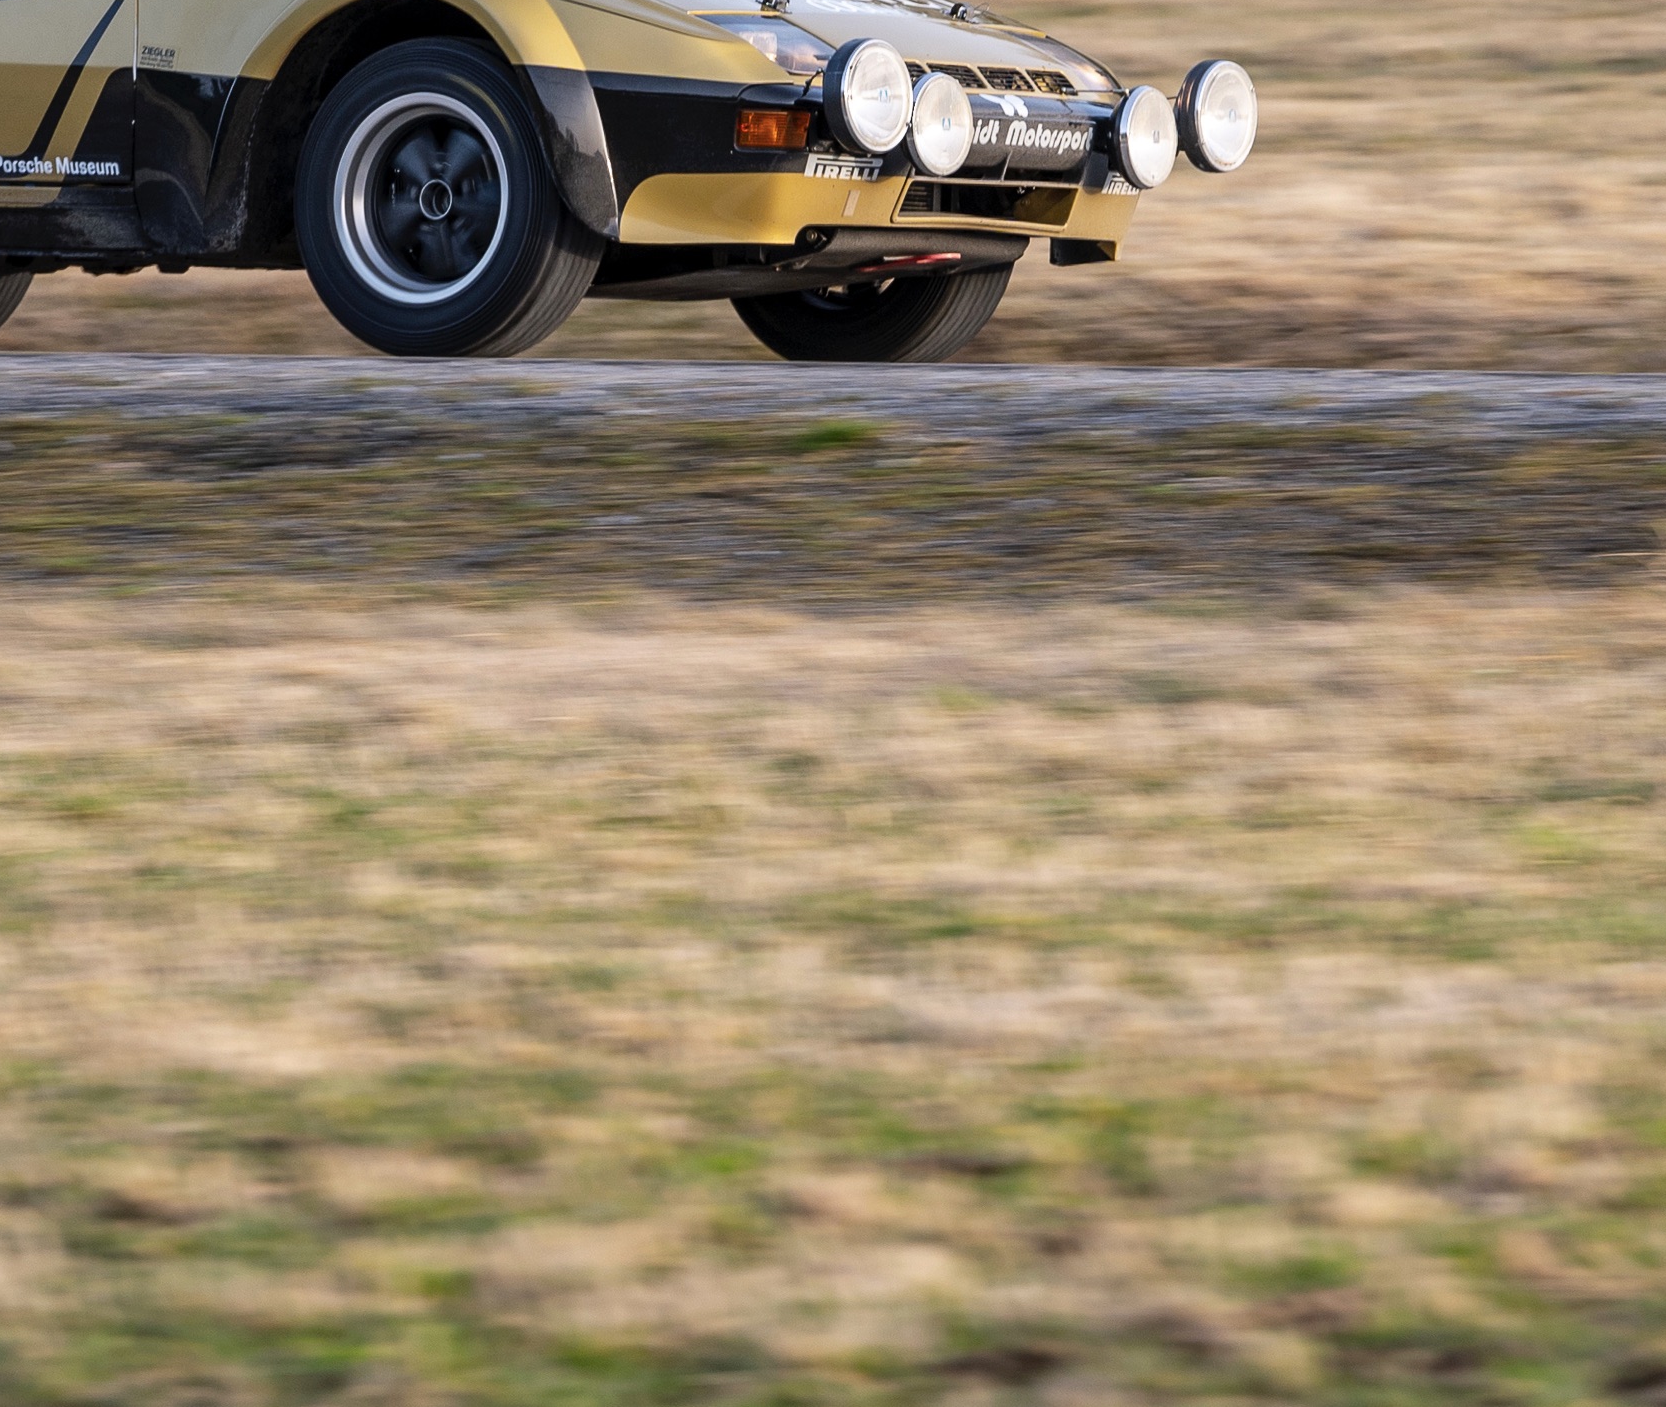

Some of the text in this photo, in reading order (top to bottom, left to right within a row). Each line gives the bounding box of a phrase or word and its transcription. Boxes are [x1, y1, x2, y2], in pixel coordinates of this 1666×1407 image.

[141, 45, 176, 58] ZIEGLER
[1004, 119, 1093, 155] Motorsport
[55, 156, 120, 176] Museum
[804, 153, 884, 182] PIRELLI
